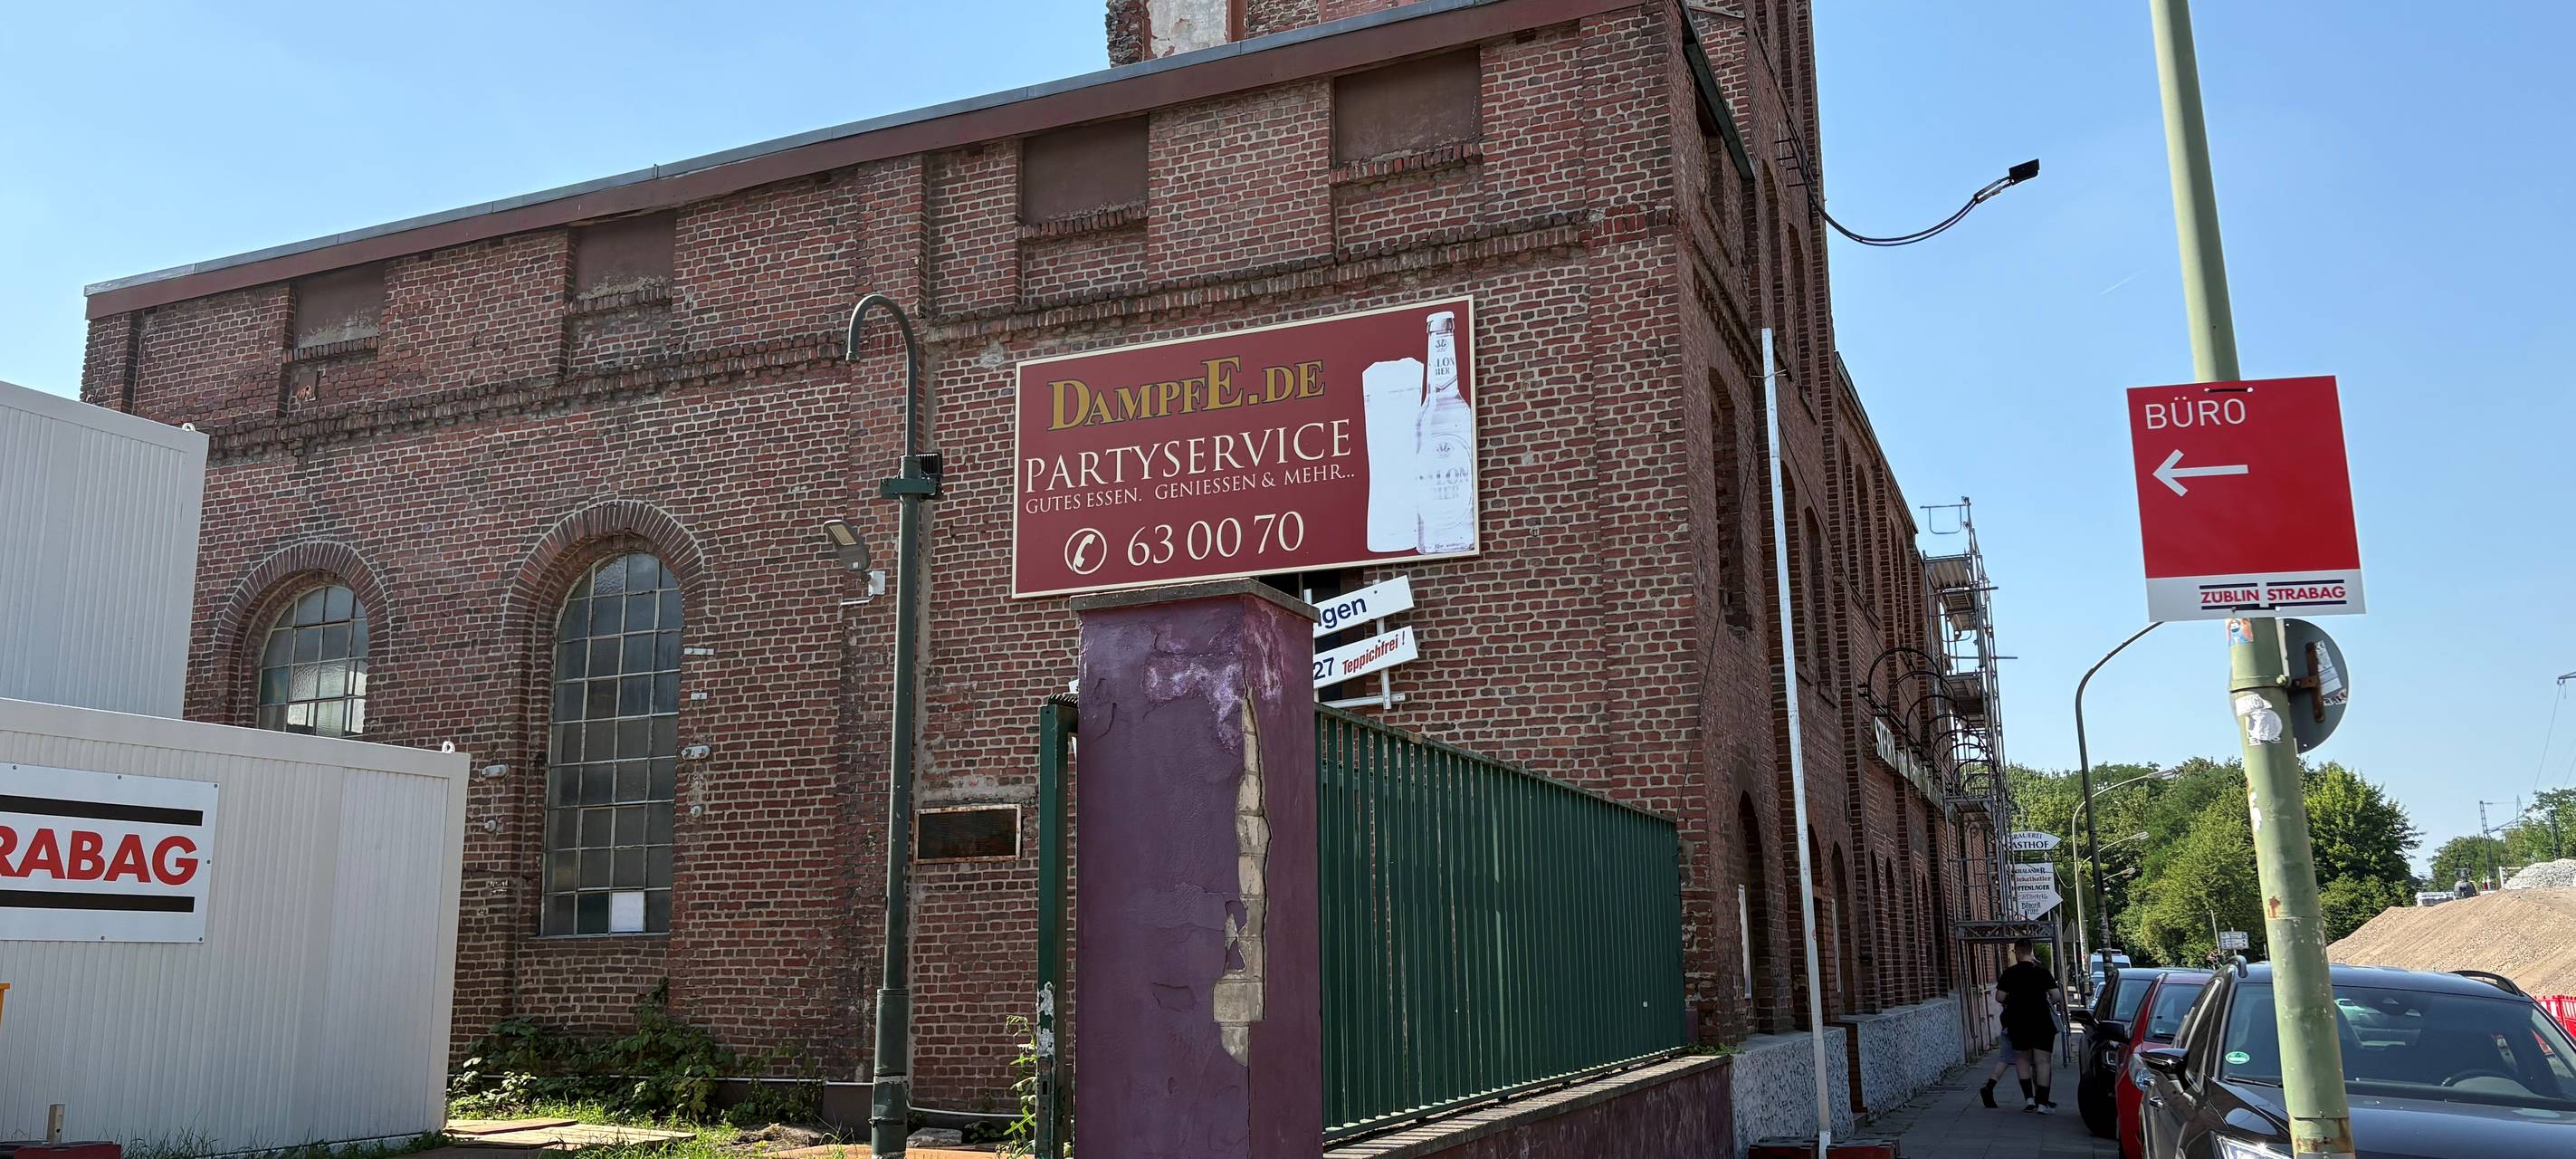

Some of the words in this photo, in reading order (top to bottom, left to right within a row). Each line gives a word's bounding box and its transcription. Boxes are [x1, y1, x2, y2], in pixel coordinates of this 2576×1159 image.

[2145, 397, 2247, 430] BÜRO
[1025, 418, 1351, 493] PARTYSERVICE
[1026, 494, 1081, 514] GUTES
[1087, 487, 1142, 508] ESSEN.
[1155, 474, 1255, 500] GENIESSEN
[1262, 472, 1276, 488] &
[1127, 524, 1174, 566] 63
[1187, 517, 1242, 560] 00
[1254, 511, 1304, 554] 70
[2200, 589, 2259, 604] ZÜBLIN
[2267, 586, 2346, 601] STRABAG
[2012, 840, 2049, 849] ASTHOF
